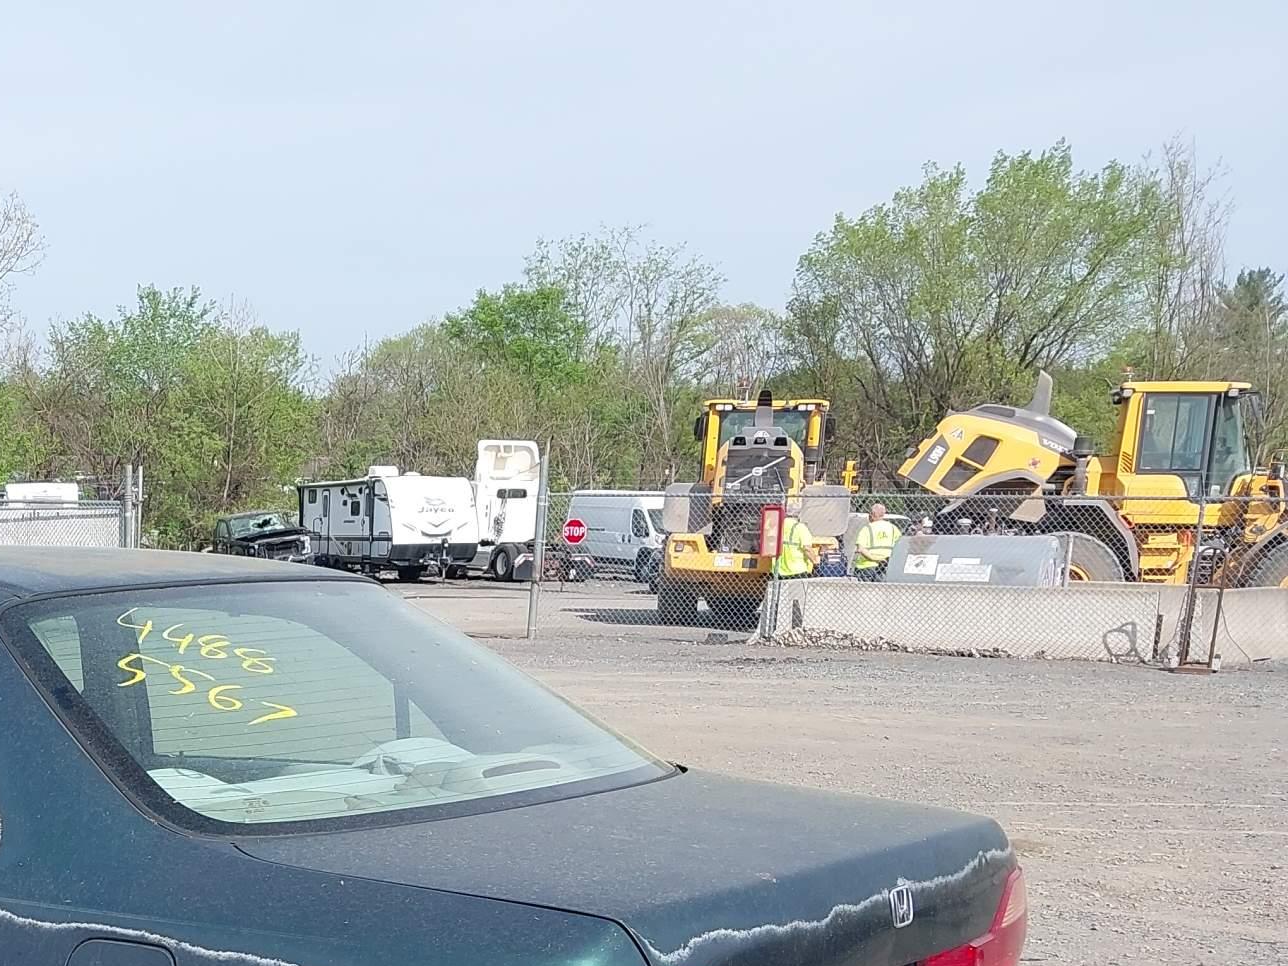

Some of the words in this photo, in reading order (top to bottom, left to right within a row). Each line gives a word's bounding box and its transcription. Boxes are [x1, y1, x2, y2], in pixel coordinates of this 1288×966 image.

[417, 505, 455, 514] Jayco
[564, 526, 585, 537] STOP
[116, 606, 277, 675] 4488
[116, 652, 299, 726] 5567
